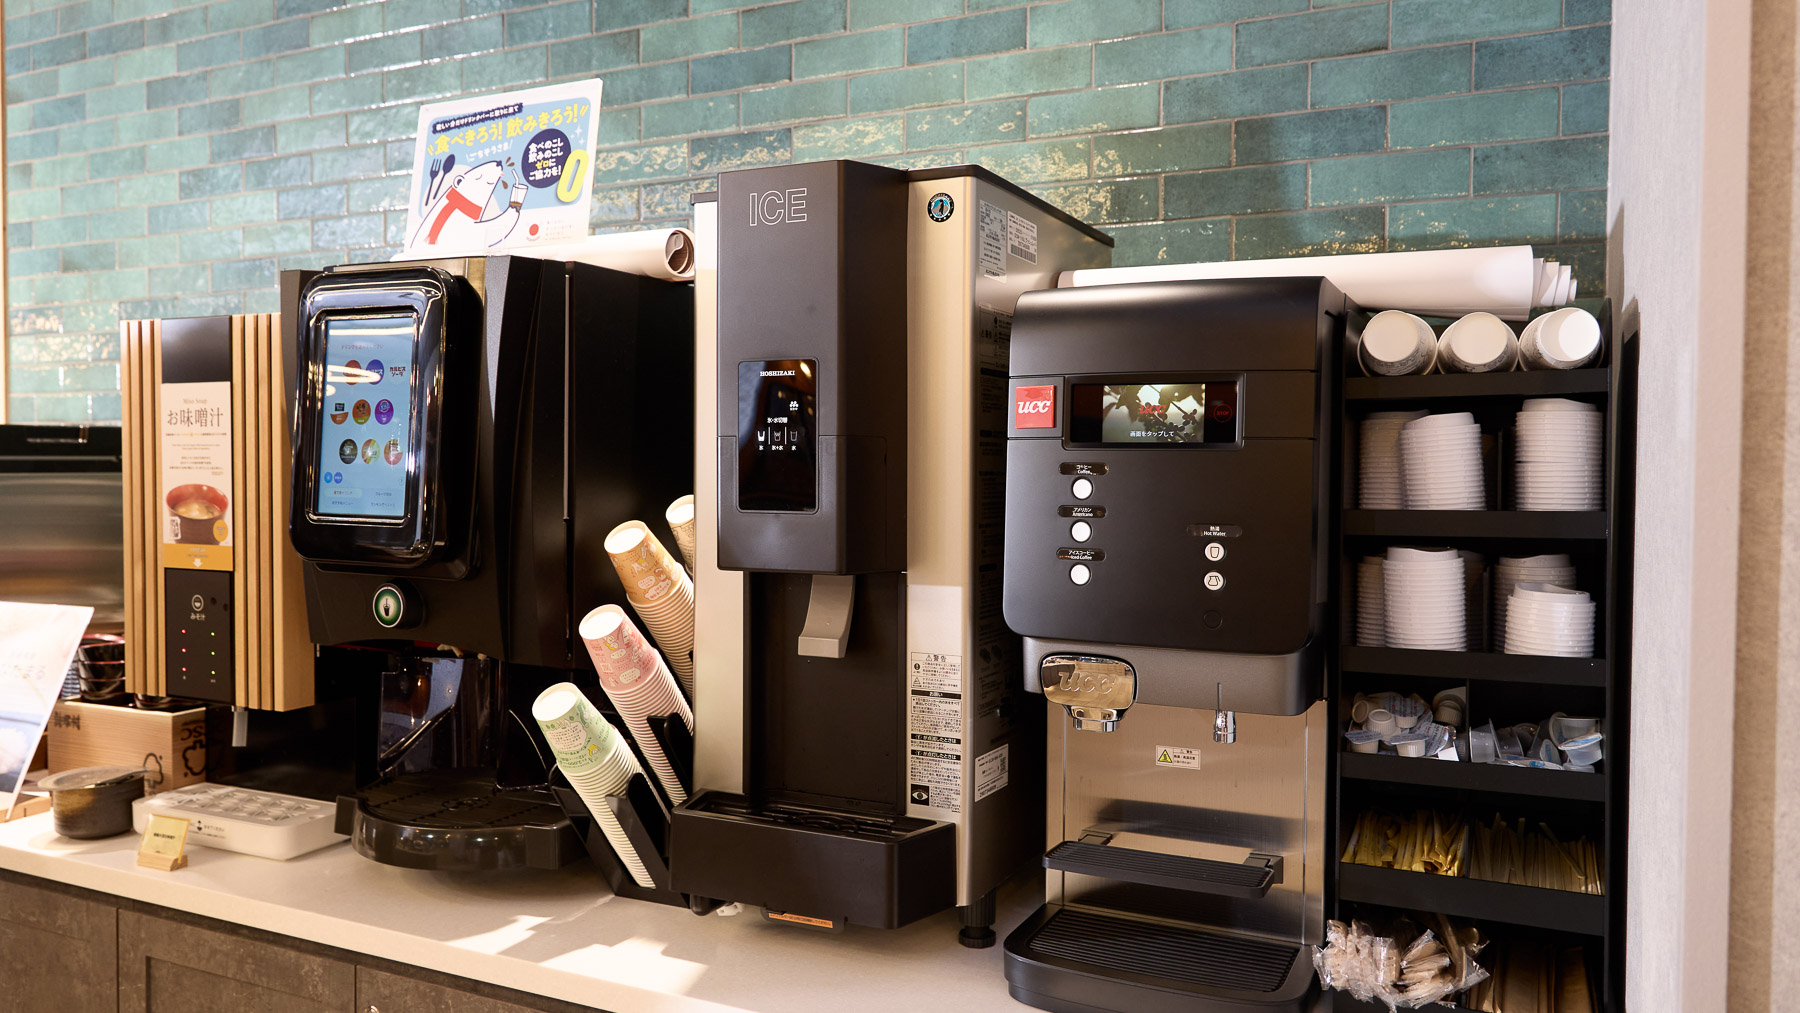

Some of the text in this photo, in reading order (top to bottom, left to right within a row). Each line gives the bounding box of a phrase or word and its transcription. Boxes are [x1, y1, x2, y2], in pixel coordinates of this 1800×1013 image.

[750, 188, 807, 226] ICE
[168, 407, 223, 427] お味噌汁
